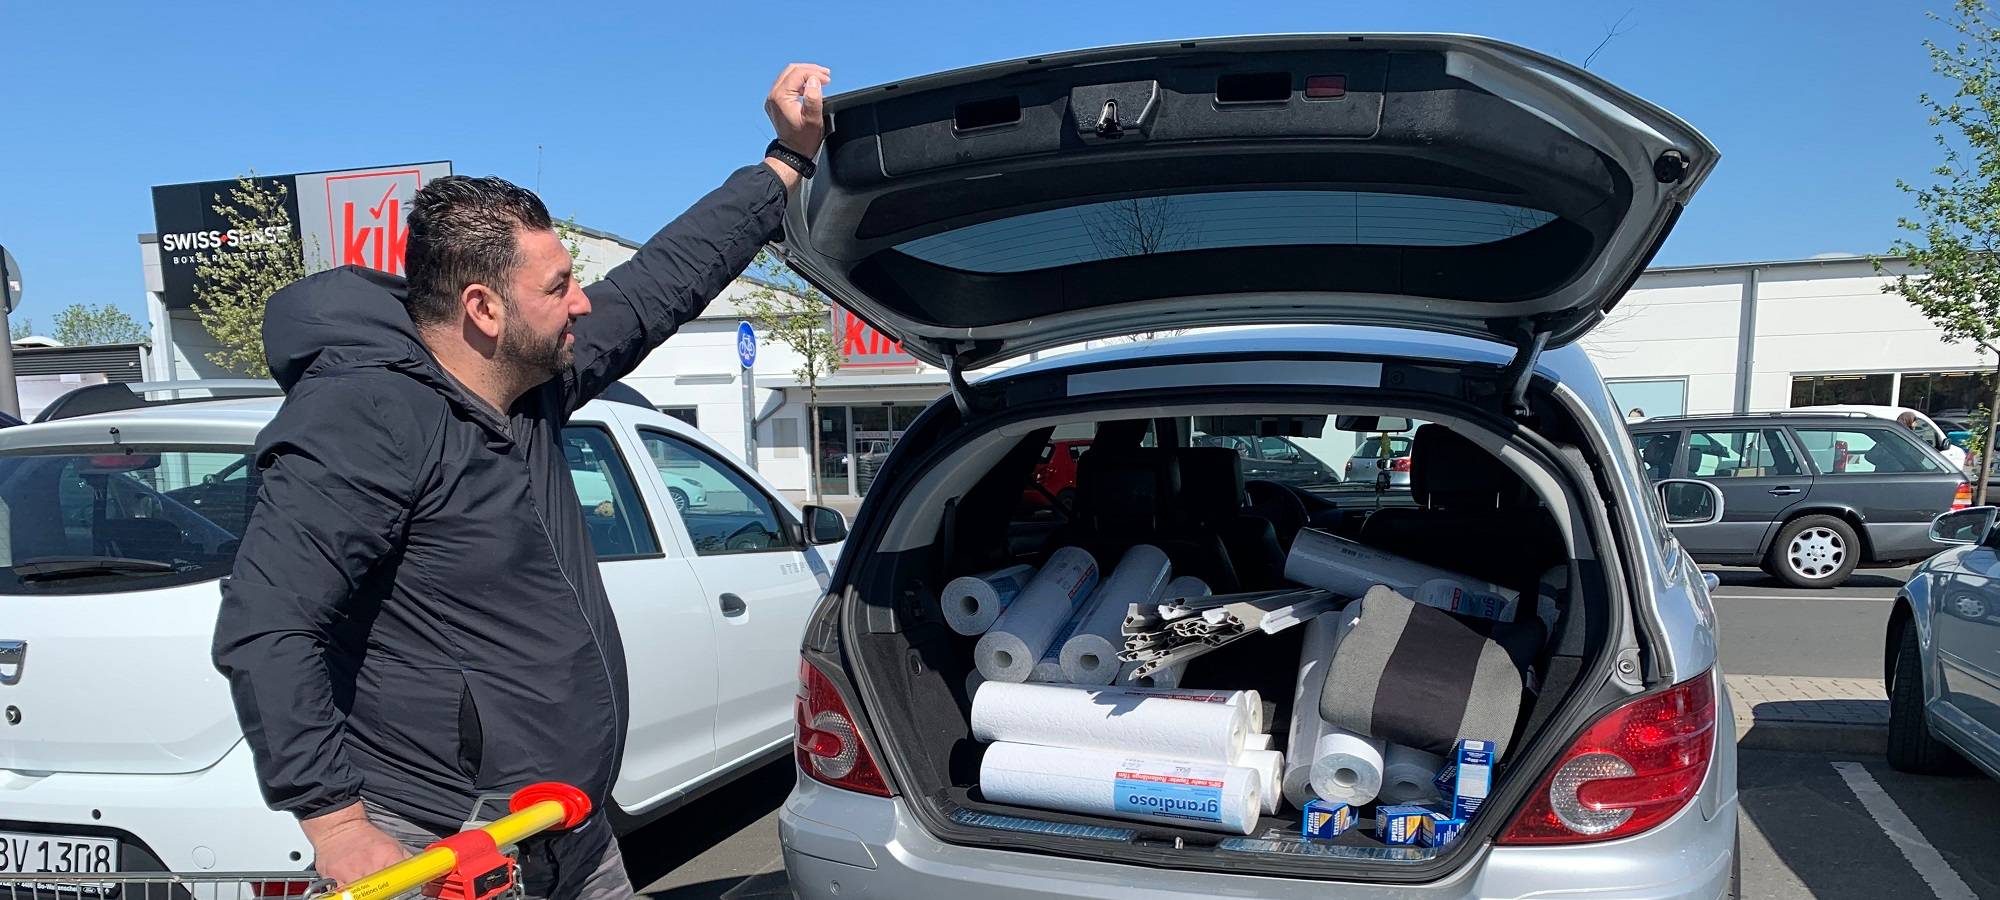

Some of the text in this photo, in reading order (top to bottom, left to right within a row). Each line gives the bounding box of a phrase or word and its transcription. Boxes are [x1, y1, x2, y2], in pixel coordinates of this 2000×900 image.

[163, 230, 221, 252] SWISS
[1129, 794, 1219, 813] grandioso
[1397, 816, 1405, 843] KLEISTER
[36, 840, 110, 873] 1308
